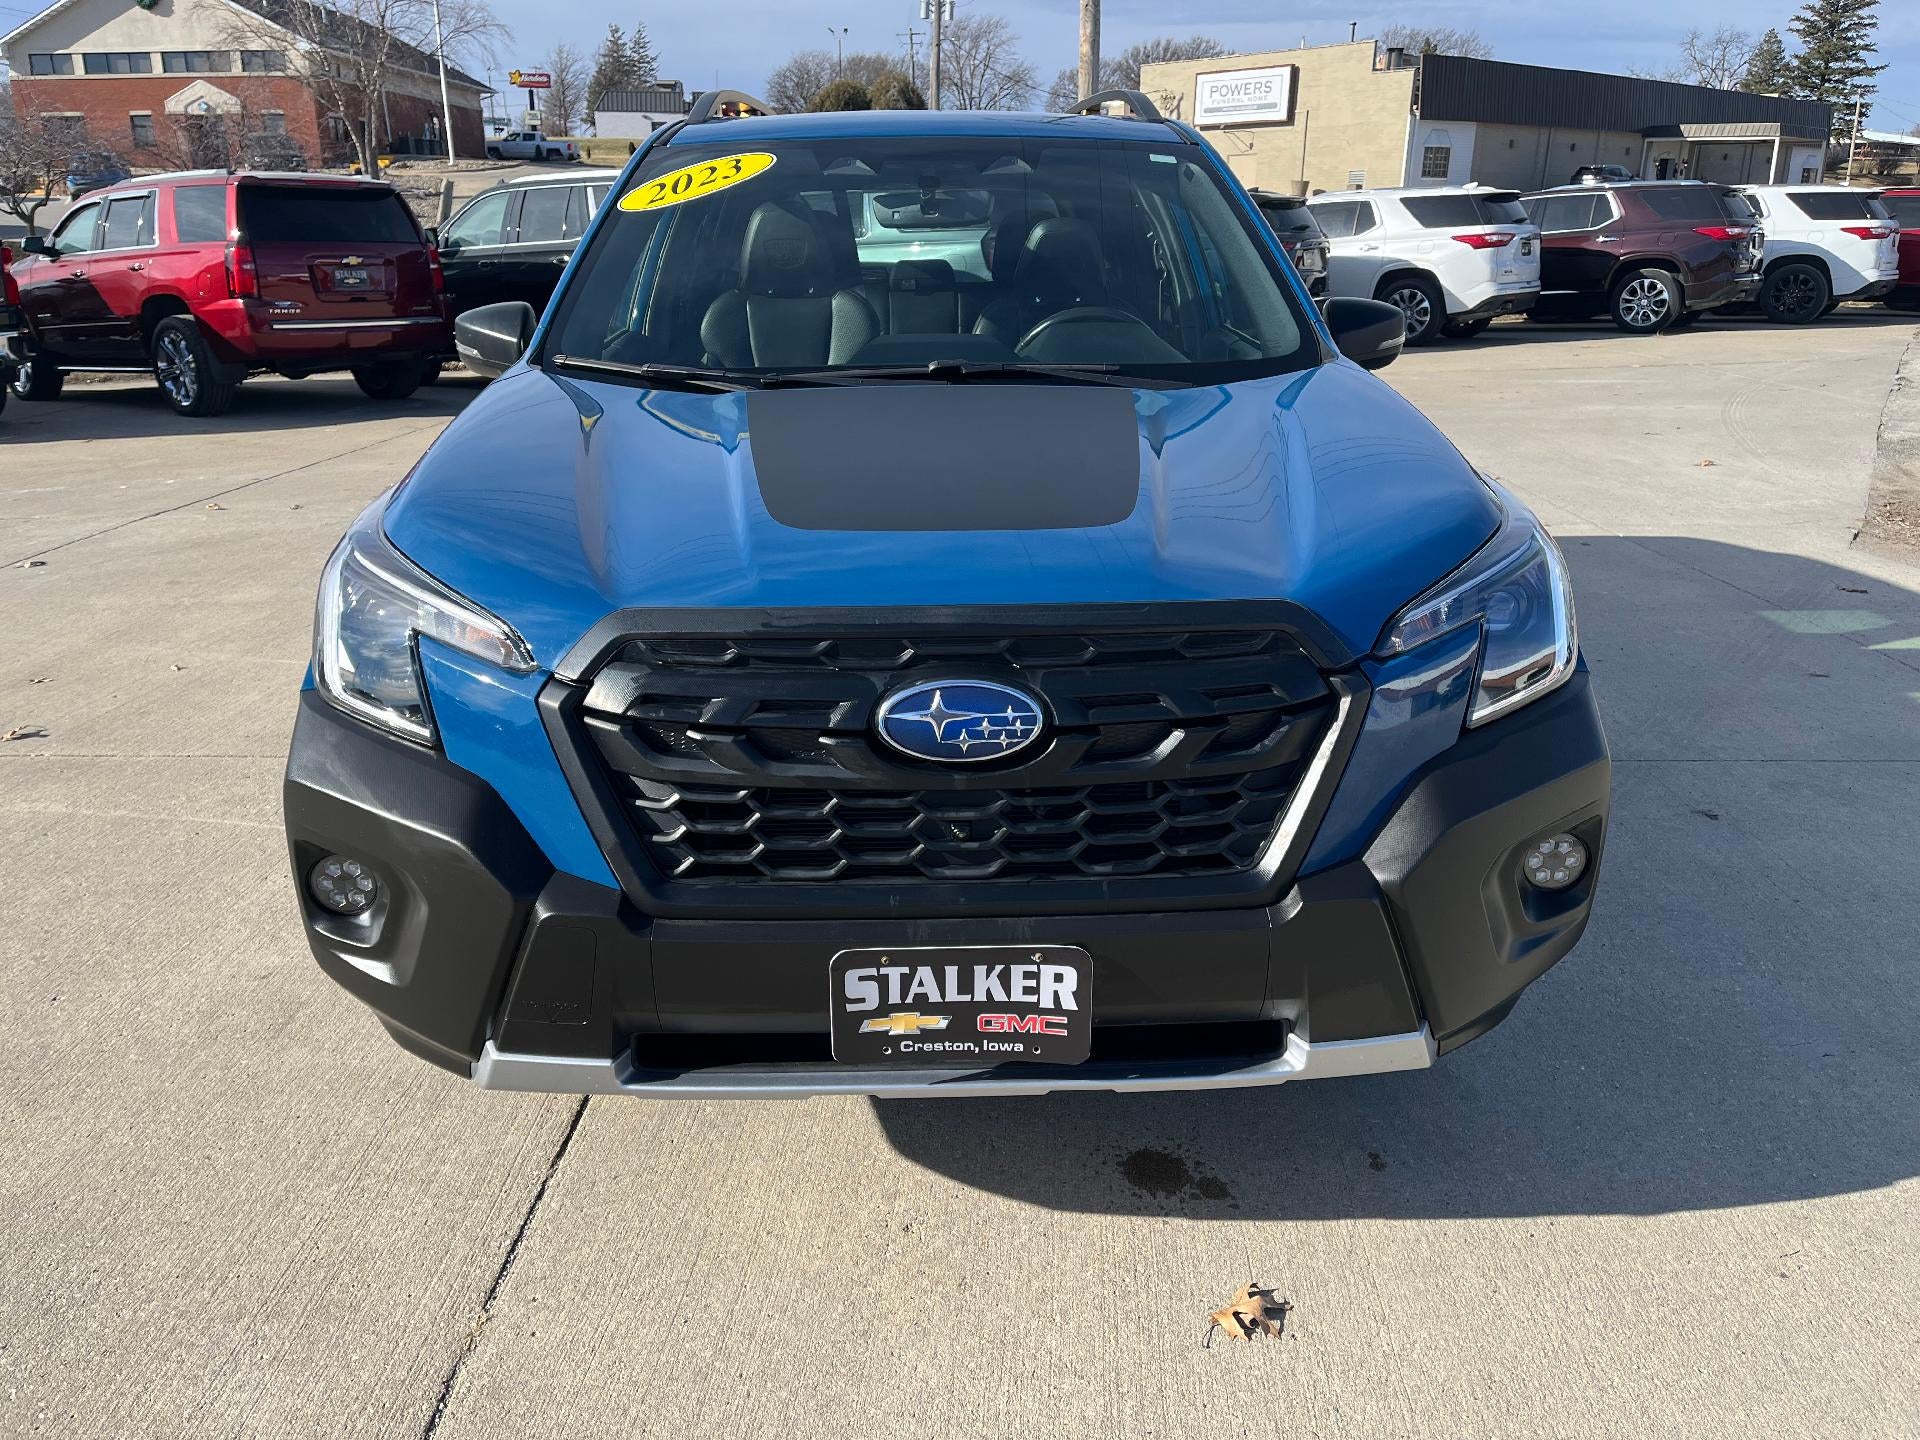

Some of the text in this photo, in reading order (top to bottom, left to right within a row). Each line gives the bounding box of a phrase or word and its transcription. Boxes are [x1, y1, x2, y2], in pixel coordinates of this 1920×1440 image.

[1210, 81, 1273, 98] POWERS
[648, 159, 742, 205] 2023
[335, 270, 368, 280] STALKER
[844, 964, 1079, 1012] STALKER
[976, 1013, 1068, 1036] GMC
[900, 1039, 1024, 1053] Creston, Iowa
